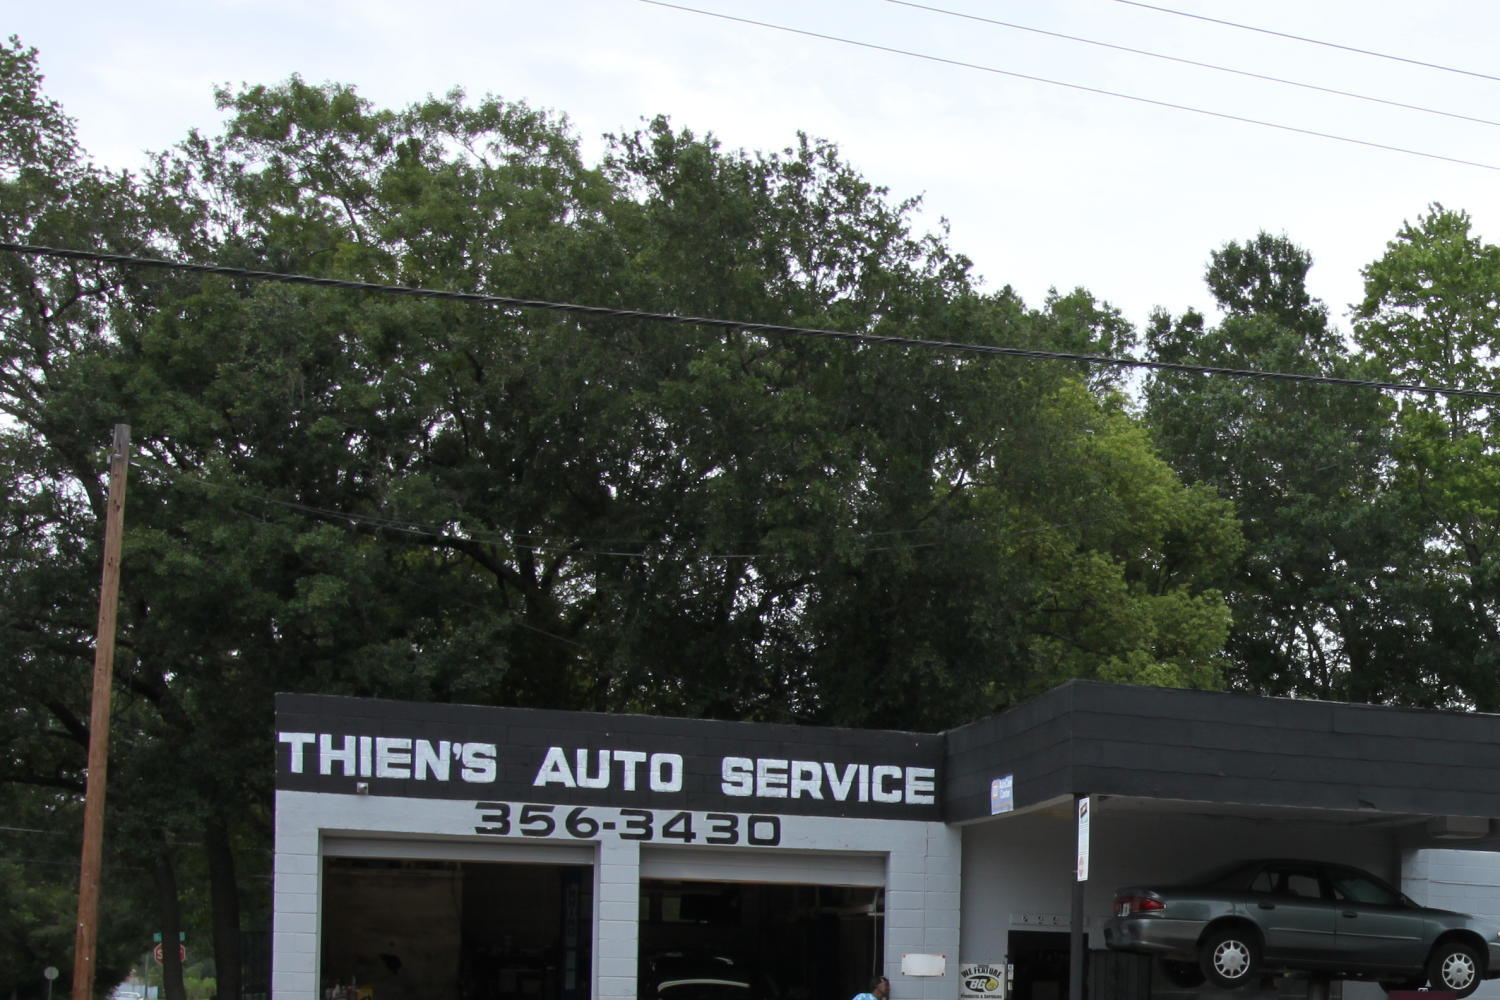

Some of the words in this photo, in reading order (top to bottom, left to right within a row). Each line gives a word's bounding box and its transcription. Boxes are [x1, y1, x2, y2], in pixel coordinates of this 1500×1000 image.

[279, 732, 497, 783] THIEN'S
[532, 747, 683, 792] AUTO
[721, 756, 935, 805] SERVICE
[474, 802, 781, 847] 356-3430
